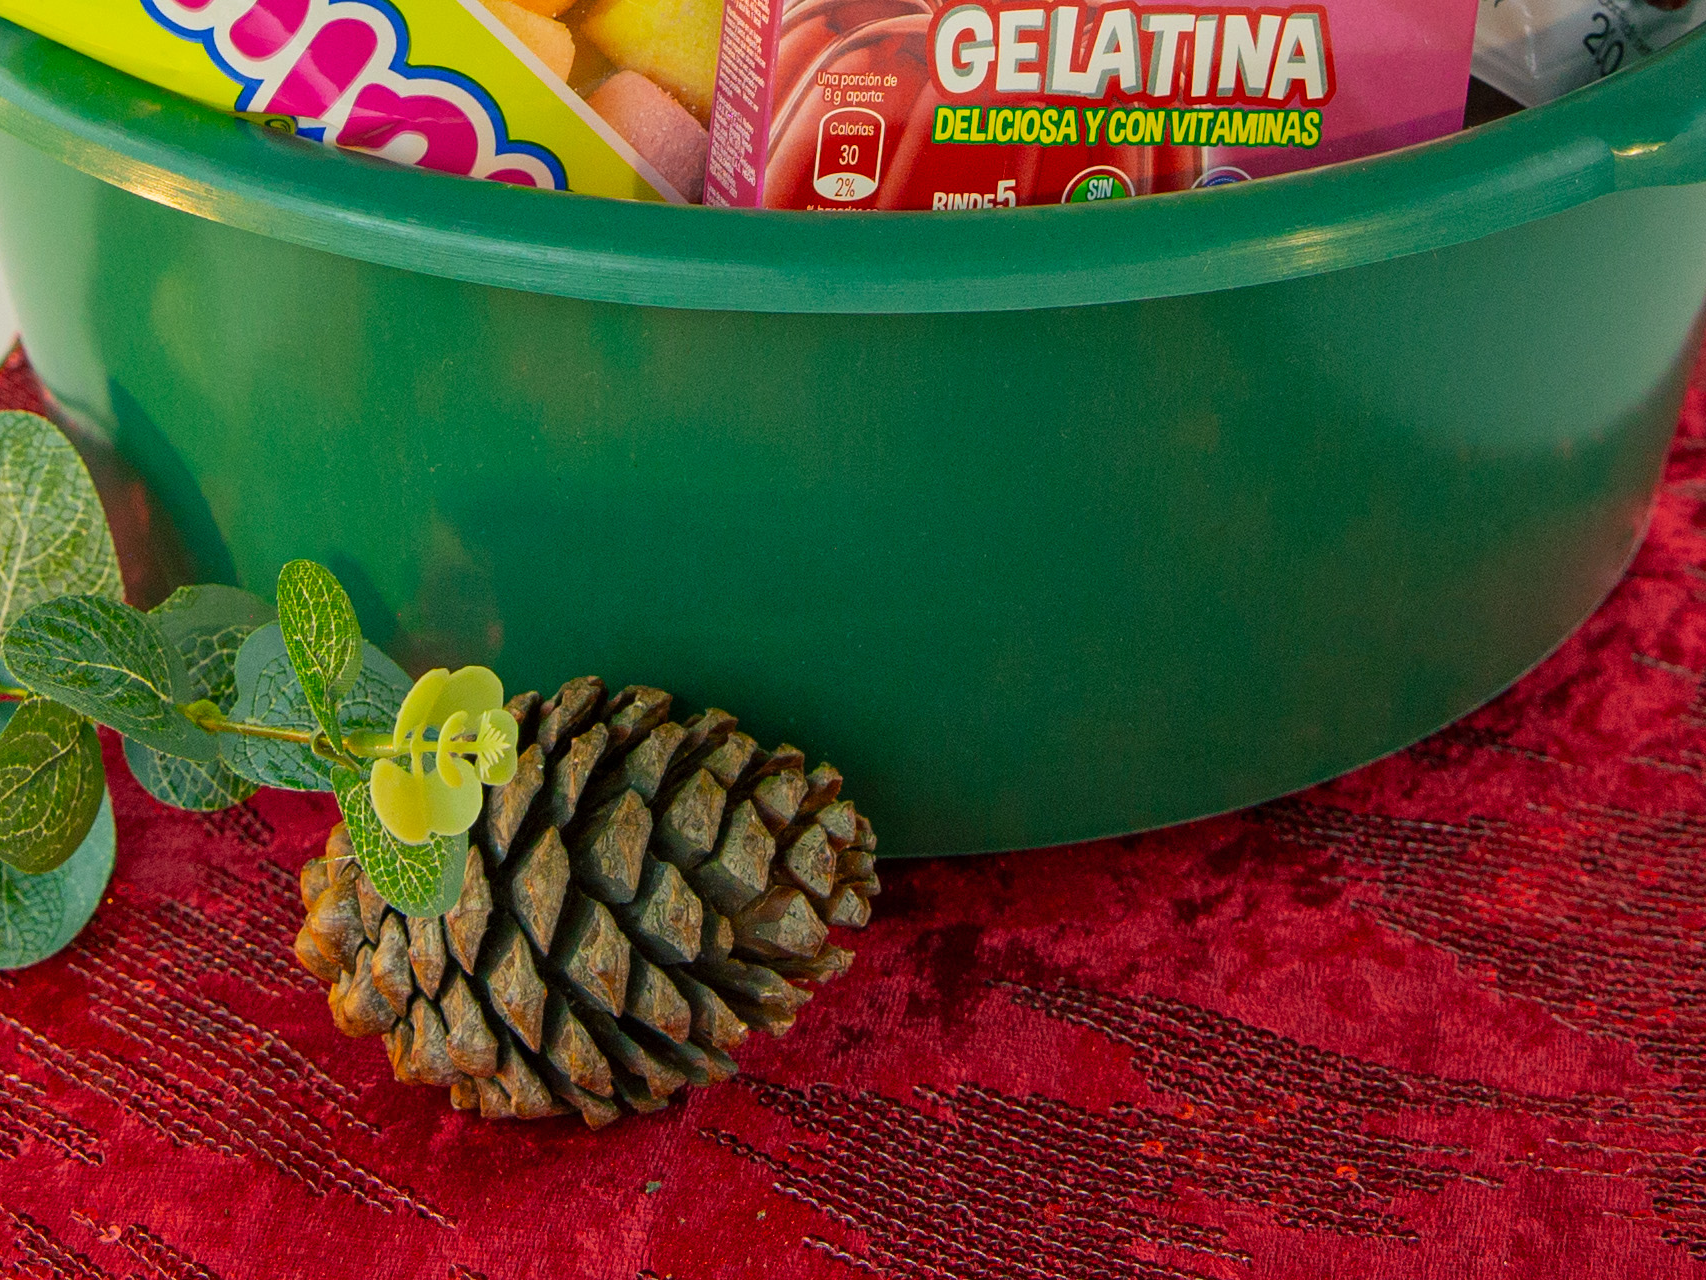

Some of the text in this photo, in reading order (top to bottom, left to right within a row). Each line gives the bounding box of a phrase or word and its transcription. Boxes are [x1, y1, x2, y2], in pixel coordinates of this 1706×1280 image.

[933, 5, 1327, 98] GELATINA
[817, 71, 897, 90] Una porción de
[824, 89, 832, 101] 8
[846, 90, 885, 106] aporta:
[830, 121, 874, 136] Calorías
[934, 109, 1320, 146] DELICIOSA Y CON VITAMINAS
[839, 144, 859, 165] 30
[834, 177, 855, 197] 2%
[996, 181, 1017, 208] 5
[1087, 178, 1114, 200] SIN
